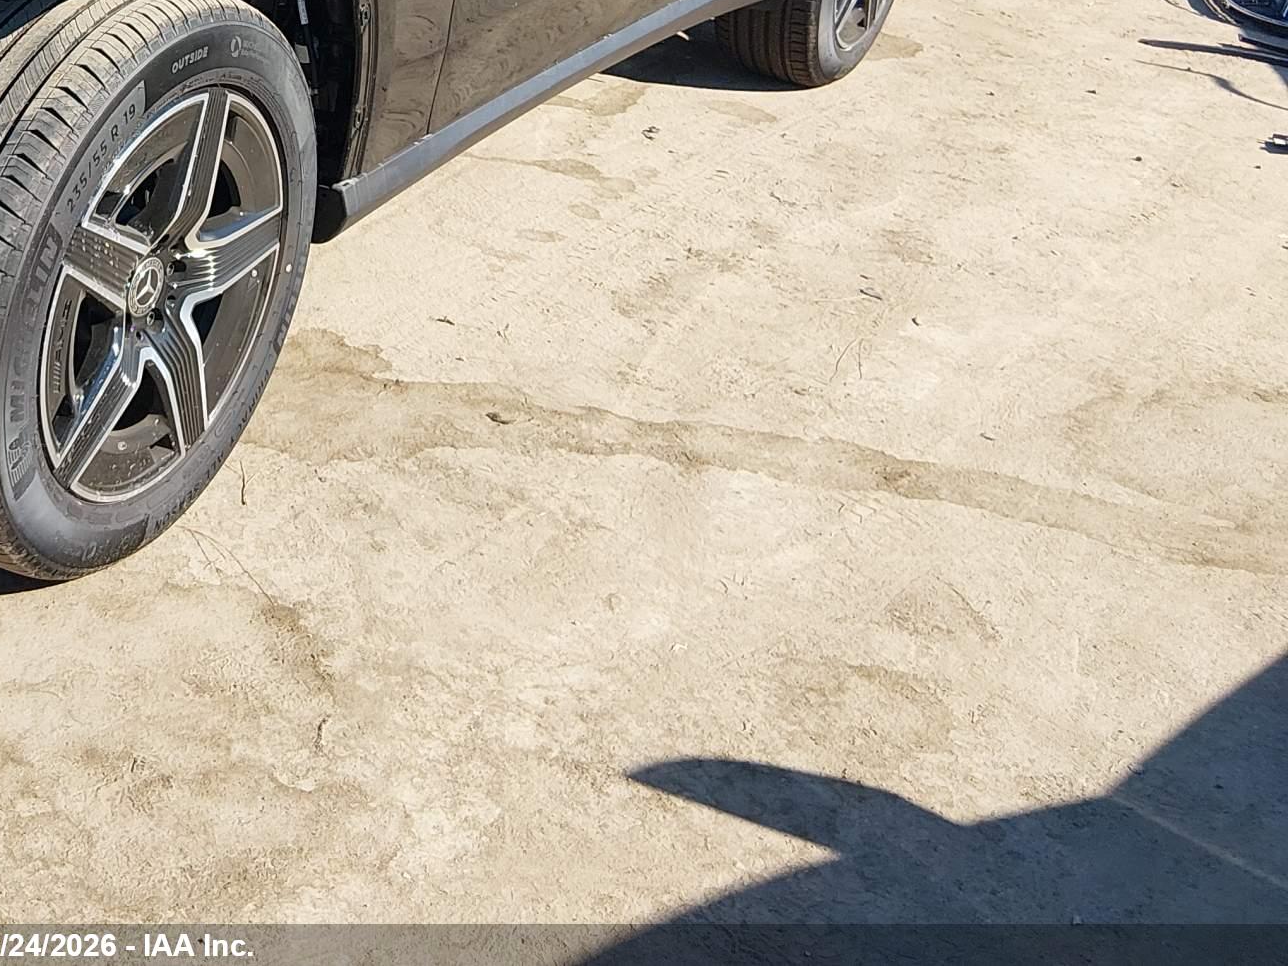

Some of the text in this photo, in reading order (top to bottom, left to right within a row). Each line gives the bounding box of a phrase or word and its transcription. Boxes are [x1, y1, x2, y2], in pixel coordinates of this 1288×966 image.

[171, 46, 209, 74] OUTSIDE
[66, 103, 136, 213] 235/55 R 19
